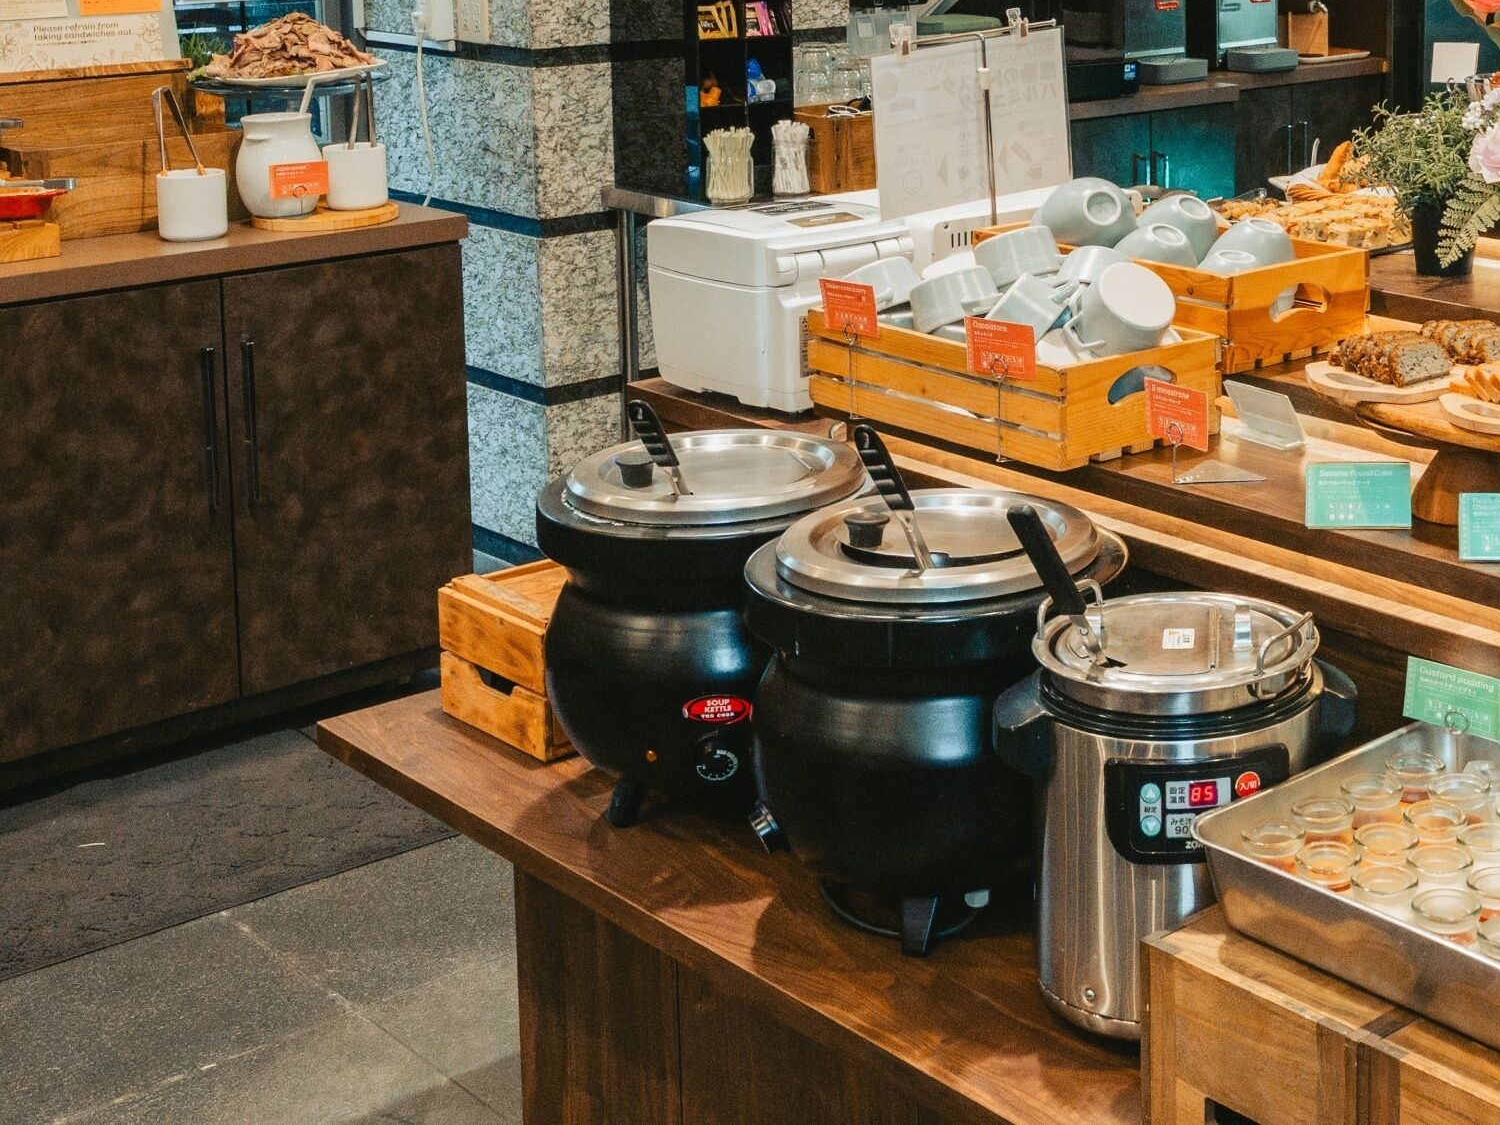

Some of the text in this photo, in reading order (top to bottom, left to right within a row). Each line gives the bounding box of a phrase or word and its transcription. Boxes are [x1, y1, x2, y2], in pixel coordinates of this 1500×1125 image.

[33, 22, 119, 33] Please refrain from
[34, 32, 62, 41] taking
[64, 30, 116, 39] sandwiches
[1419, 666, 1495, 693] Custard pudding
[706, 698, 730, 707] SOUP
[704, 705, 732, 713] KETTLE
[1239, 780, 1257, 791] 入/切
[1169, 786, 1186, 795] 設定
[1191, 785, 1214, 802] 85
[1169, 796, 1186, 804] 温度
[1171, 818, 1192, 826] みそ汁
[1175, 826, 1189, 834] 90
